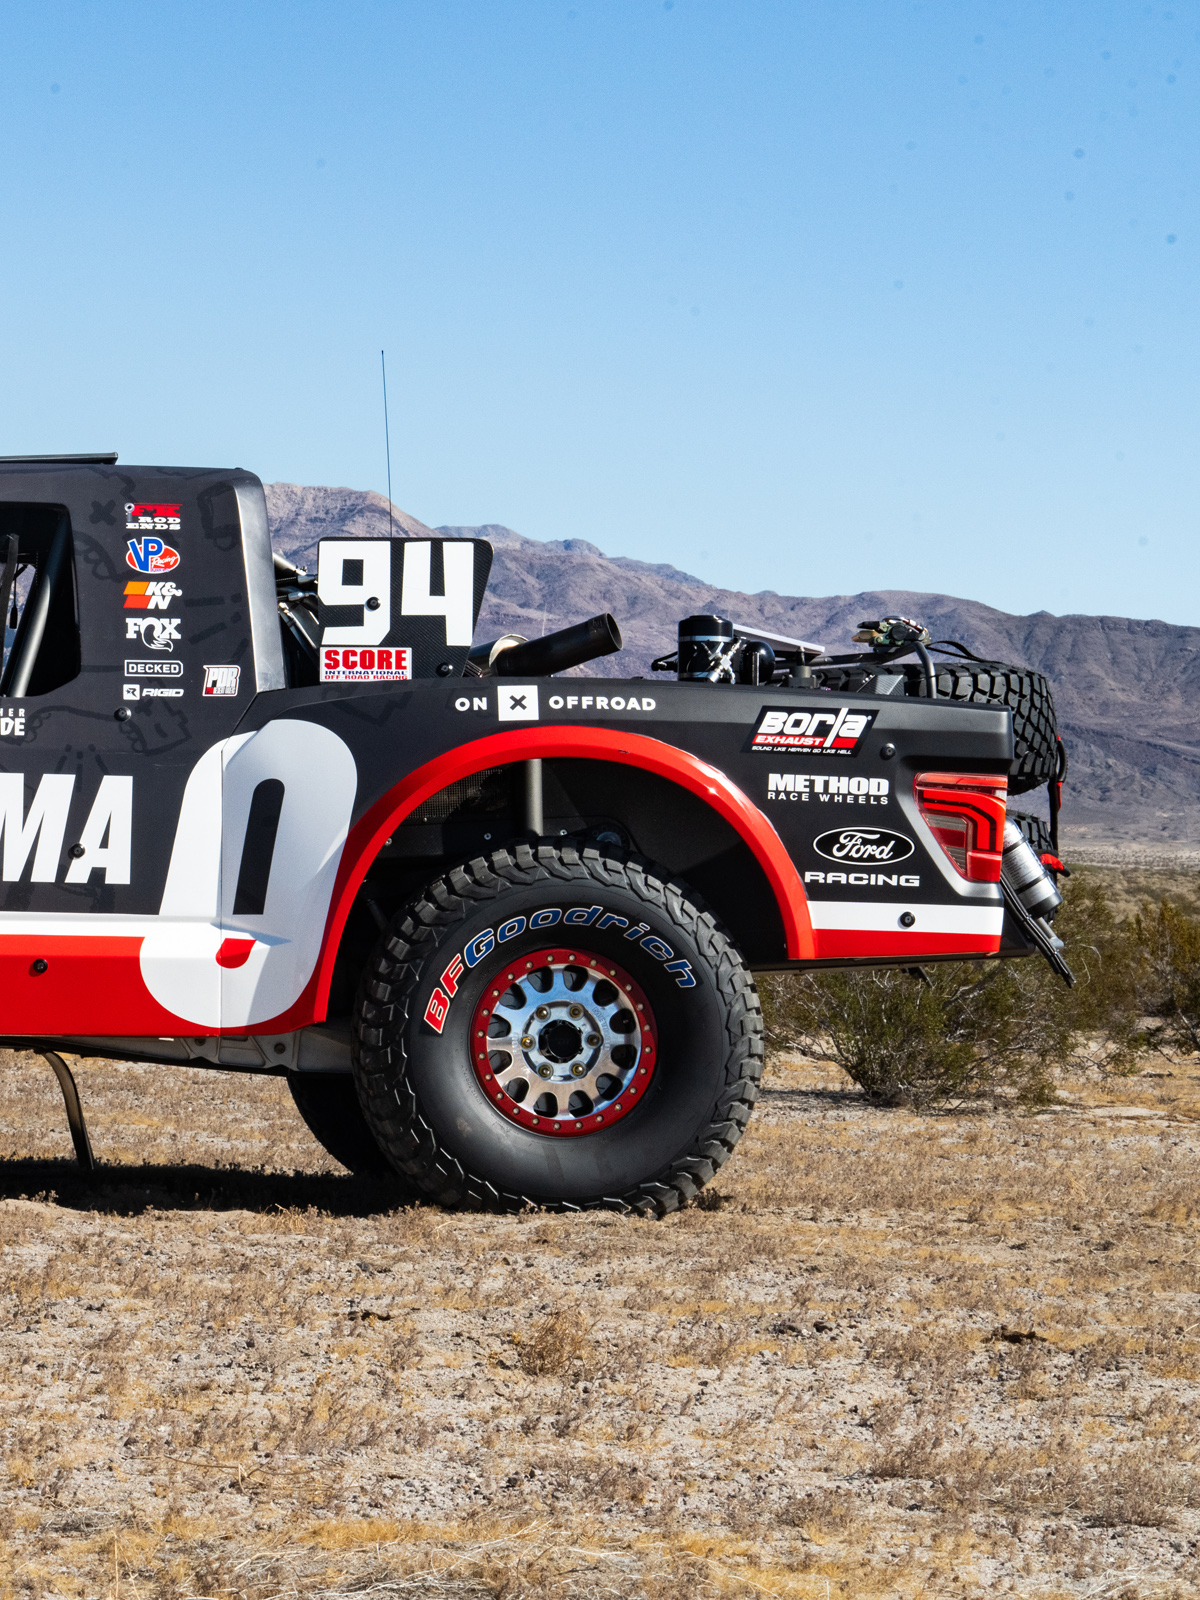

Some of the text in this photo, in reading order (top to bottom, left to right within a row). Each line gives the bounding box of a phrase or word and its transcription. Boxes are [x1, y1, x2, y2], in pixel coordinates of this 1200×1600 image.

[126, 522, 181, 530] ENDS
[138, 516, 181, 524] ROD
[127, 537, 165, 573] VP
[319, 540, 475, 646] 94
[126, 617, 181, 652] FOX
[324, 649, 408, 670] SCORE
[128, 664, 179, 673] DECKED
[142, 688, 184, 697] RIGID
[455, 697, 488, 712] ON
[549, 695, 657, 711] OFFROAD
[755, 736, 824, 746] EXHAUST
[768, 773, 890, 796] METHOD
[768, 792, 889, 805] RACE WHEELS
[832, 831, 896, 860] Ford
[804, 871, 920, 887] RACING
[424, 905, 697, 1034] BFGoodrich
